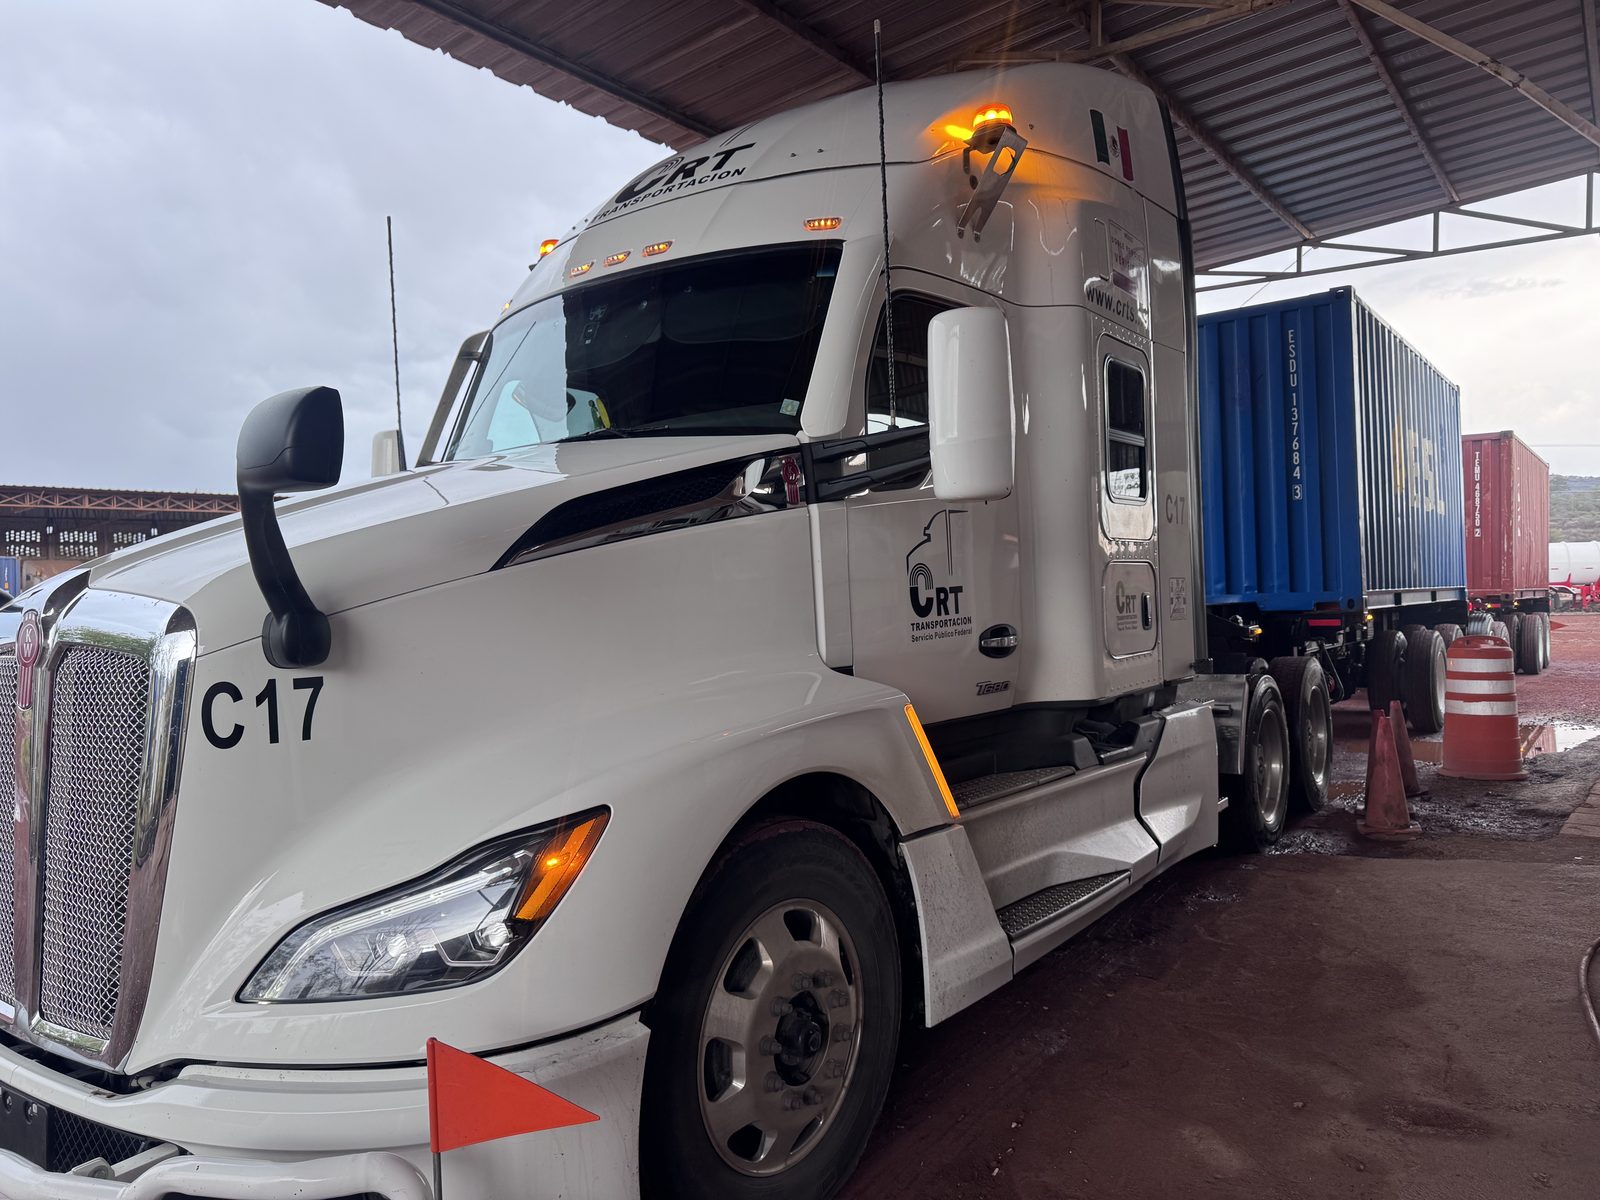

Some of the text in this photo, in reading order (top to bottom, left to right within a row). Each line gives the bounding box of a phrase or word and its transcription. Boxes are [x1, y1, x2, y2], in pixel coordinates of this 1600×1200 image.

[591, 167, 746, 223] TRANSPORTACION
[615, 142, 756, 203] CRT
[1288, 329, 1297, 387] ESDU
[1165, 494, 1185, 525] C17
[909, 562, 963, 618] CRT
[1115, 580, 1137, 614] CRT
[910, 616, 972, 632] TRANSPORTACION
[912, 633, 934, 643] Servicio
[954, 627, 973, 637] Federal
[200, 676, 324, 749] C17
